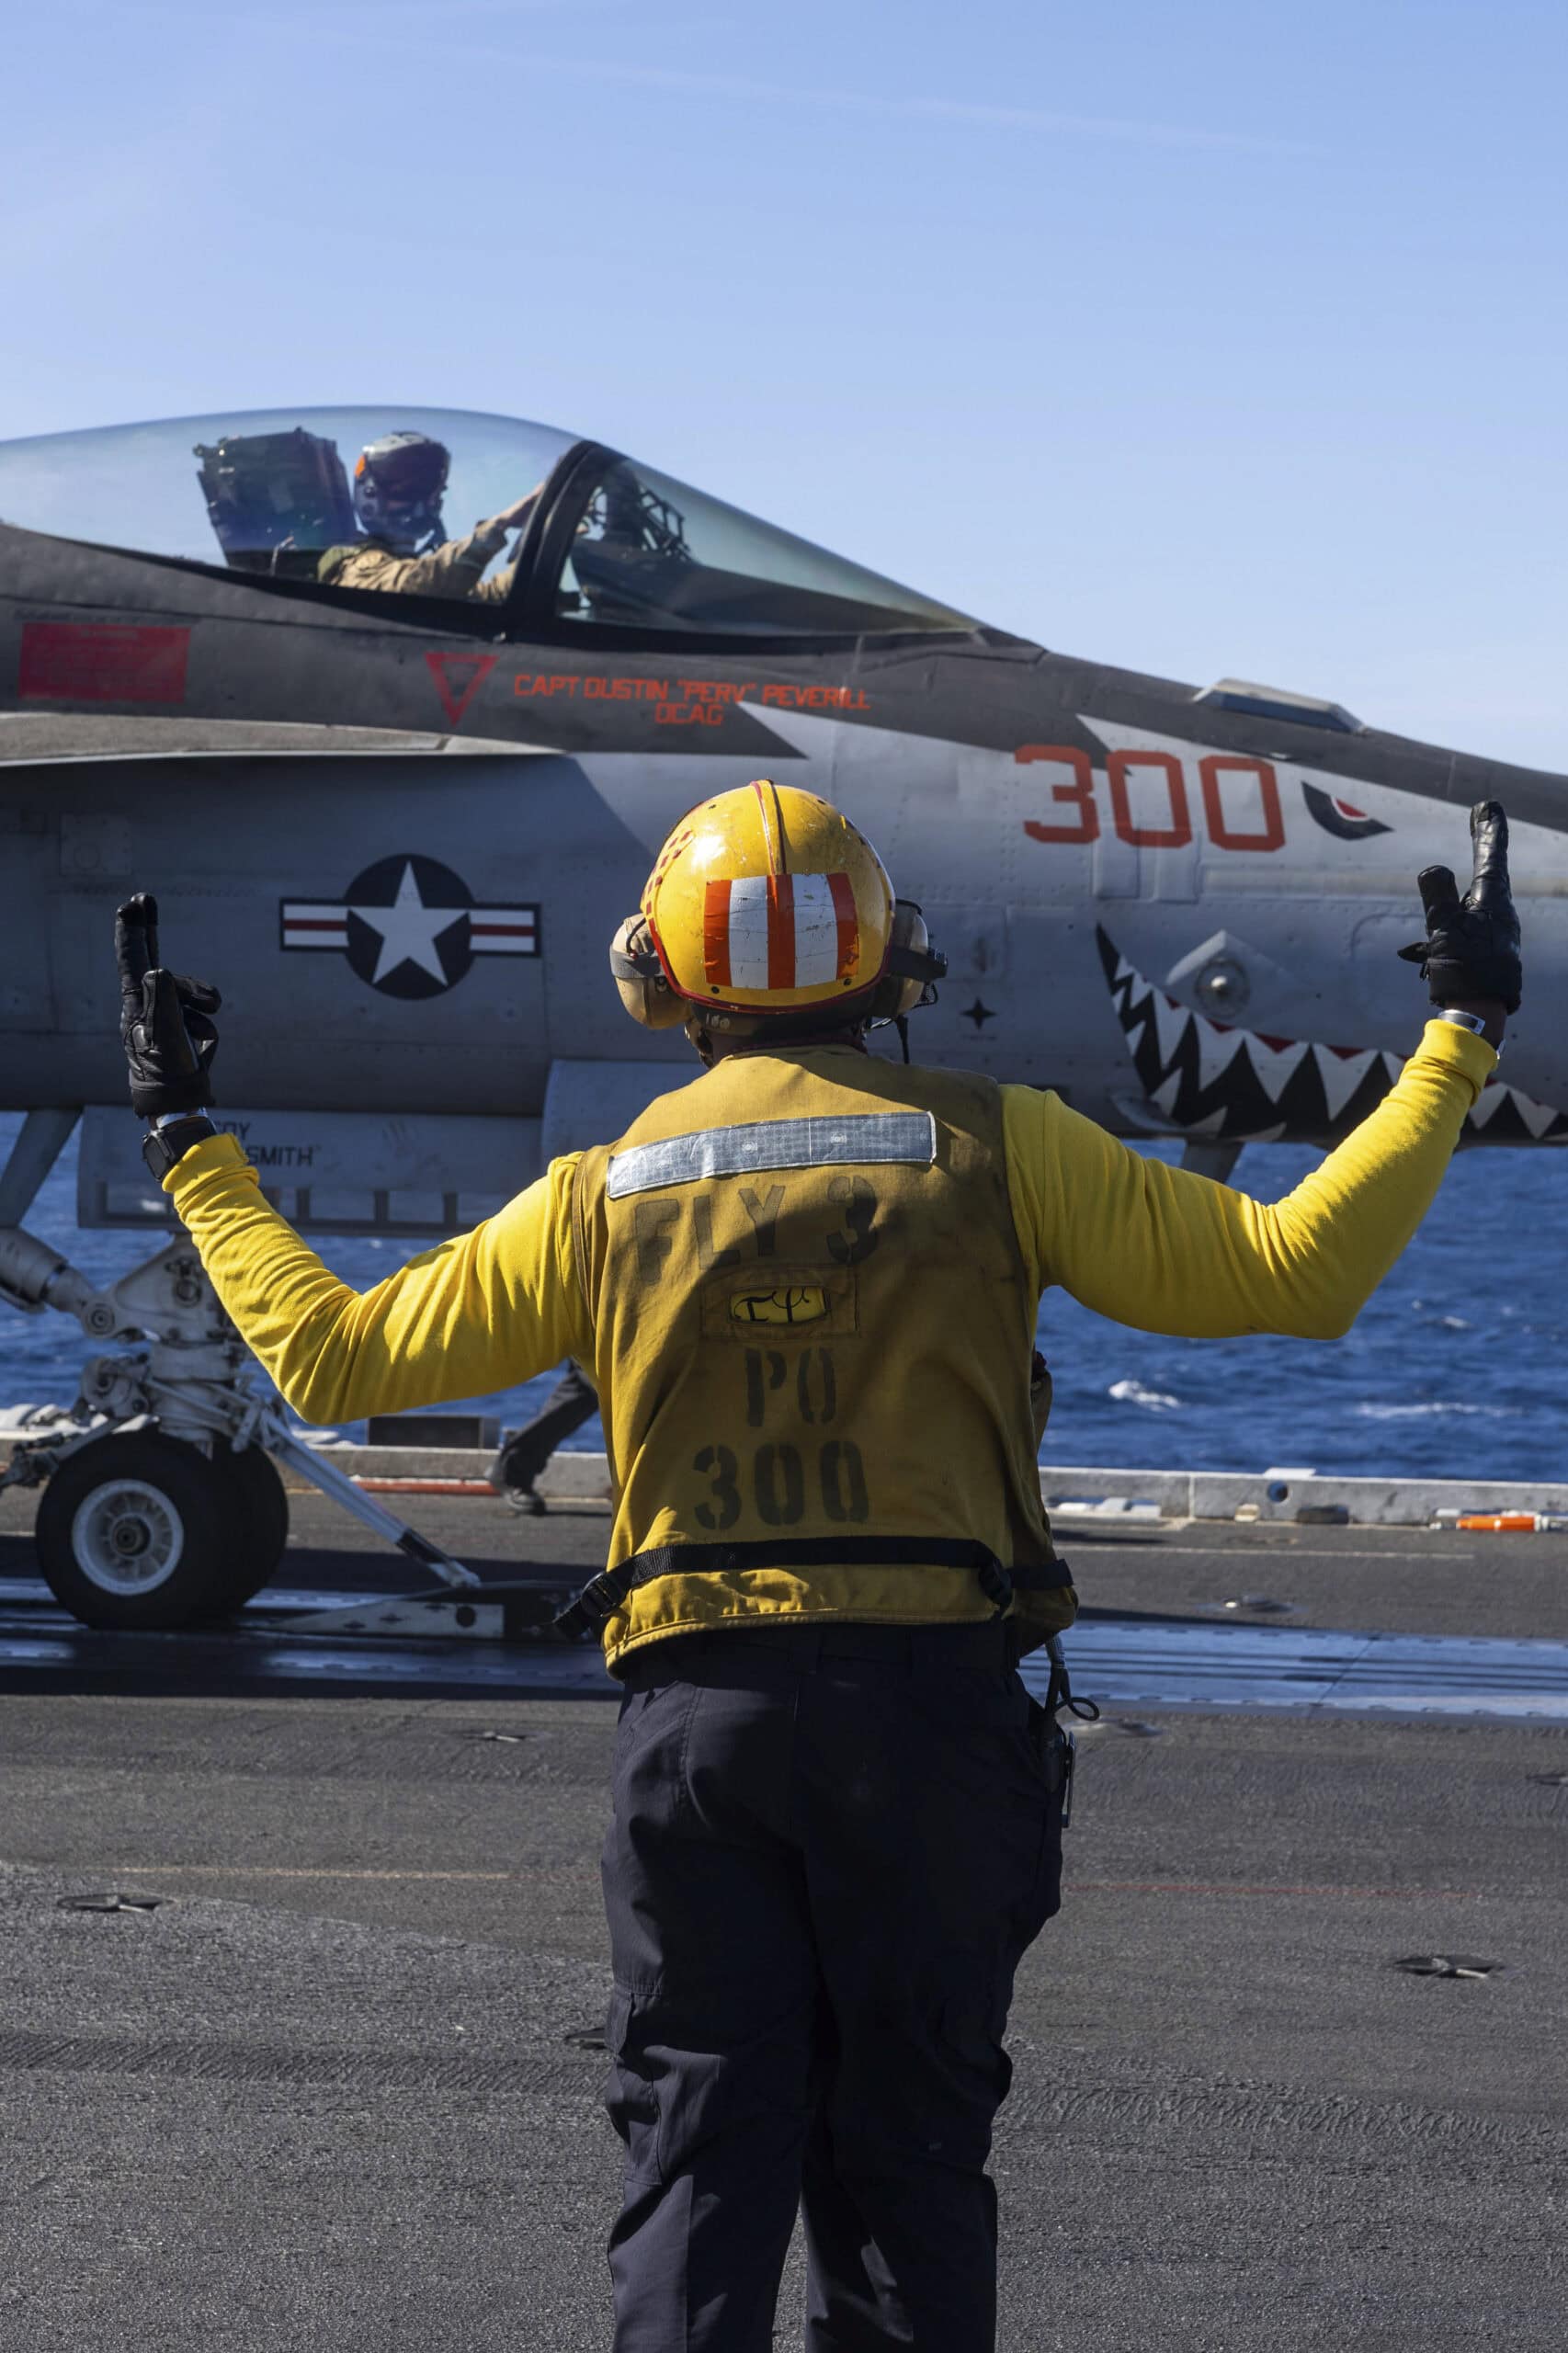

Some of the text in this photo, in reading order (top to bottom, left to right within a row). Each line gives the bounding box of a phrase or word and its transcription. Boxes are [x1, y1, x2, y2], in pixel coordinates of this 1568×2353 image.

[514, 673, 581, 699] CAPT
[583, 676, 670, 701] DUSTIN
[761, 684, 871, 710] PEVERILL
[1014, 744, 1286, 853] 300
[634, 1175, 880, 1287] FLY 3
[693, 1439, 869, 1530] 300
